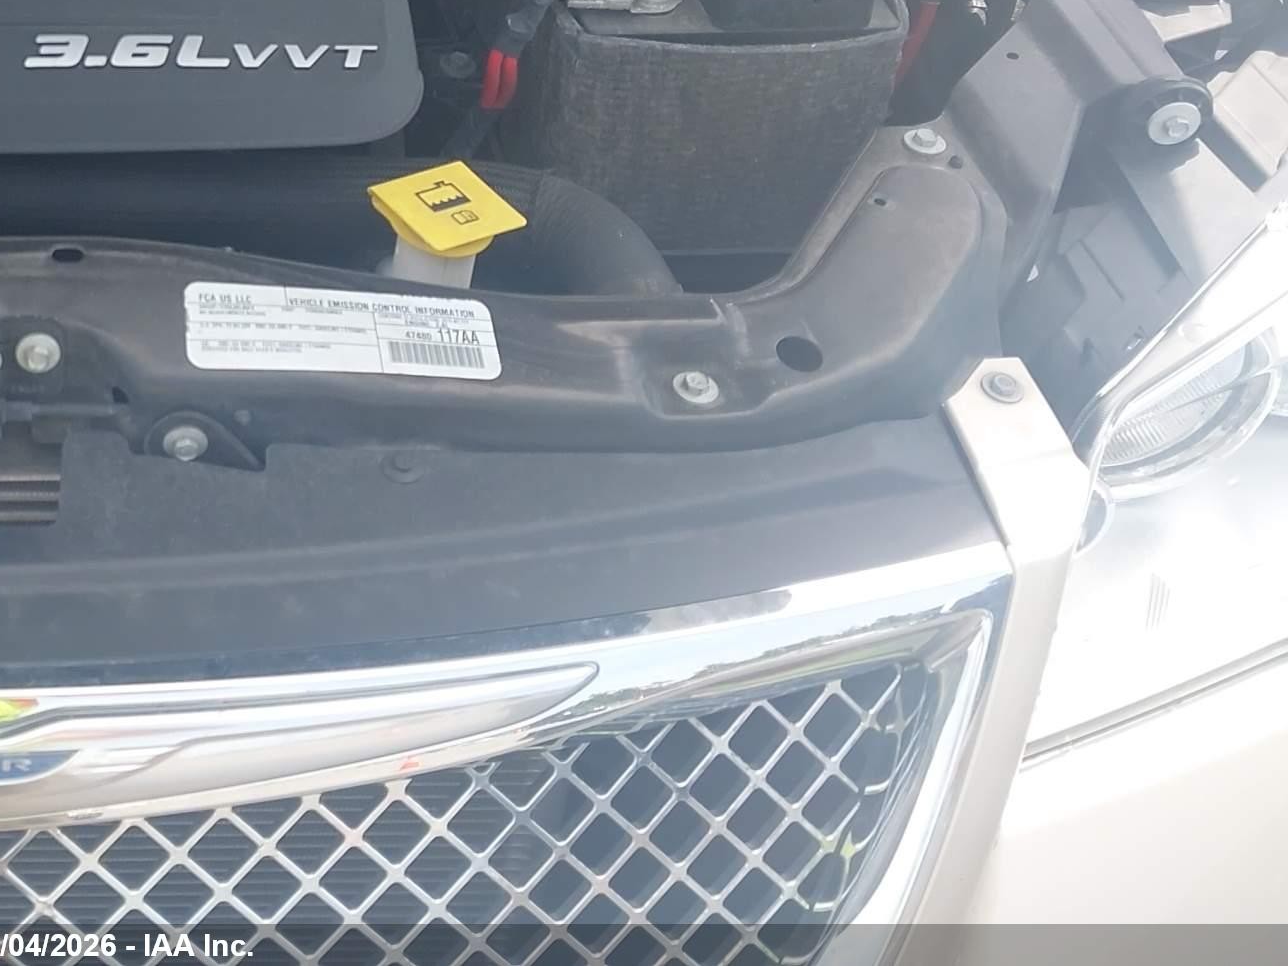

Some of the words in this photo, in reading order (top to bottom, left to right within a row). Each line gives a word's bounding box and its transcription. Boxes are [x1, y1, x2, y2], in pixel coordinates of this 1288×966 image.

[199, 293, 216, 302] FCA
[220, 294, 232, 303] US
[235, 294, 252, 304] LLC
[288, 298, 324, 308] VEHICLE
[327, 300, 370, 311] EMISSION
[372, 303, 411, 314] CONTROL
[414, 306, 475, 318] INFORMATION
[437, 328, 480, 346] 117AA
